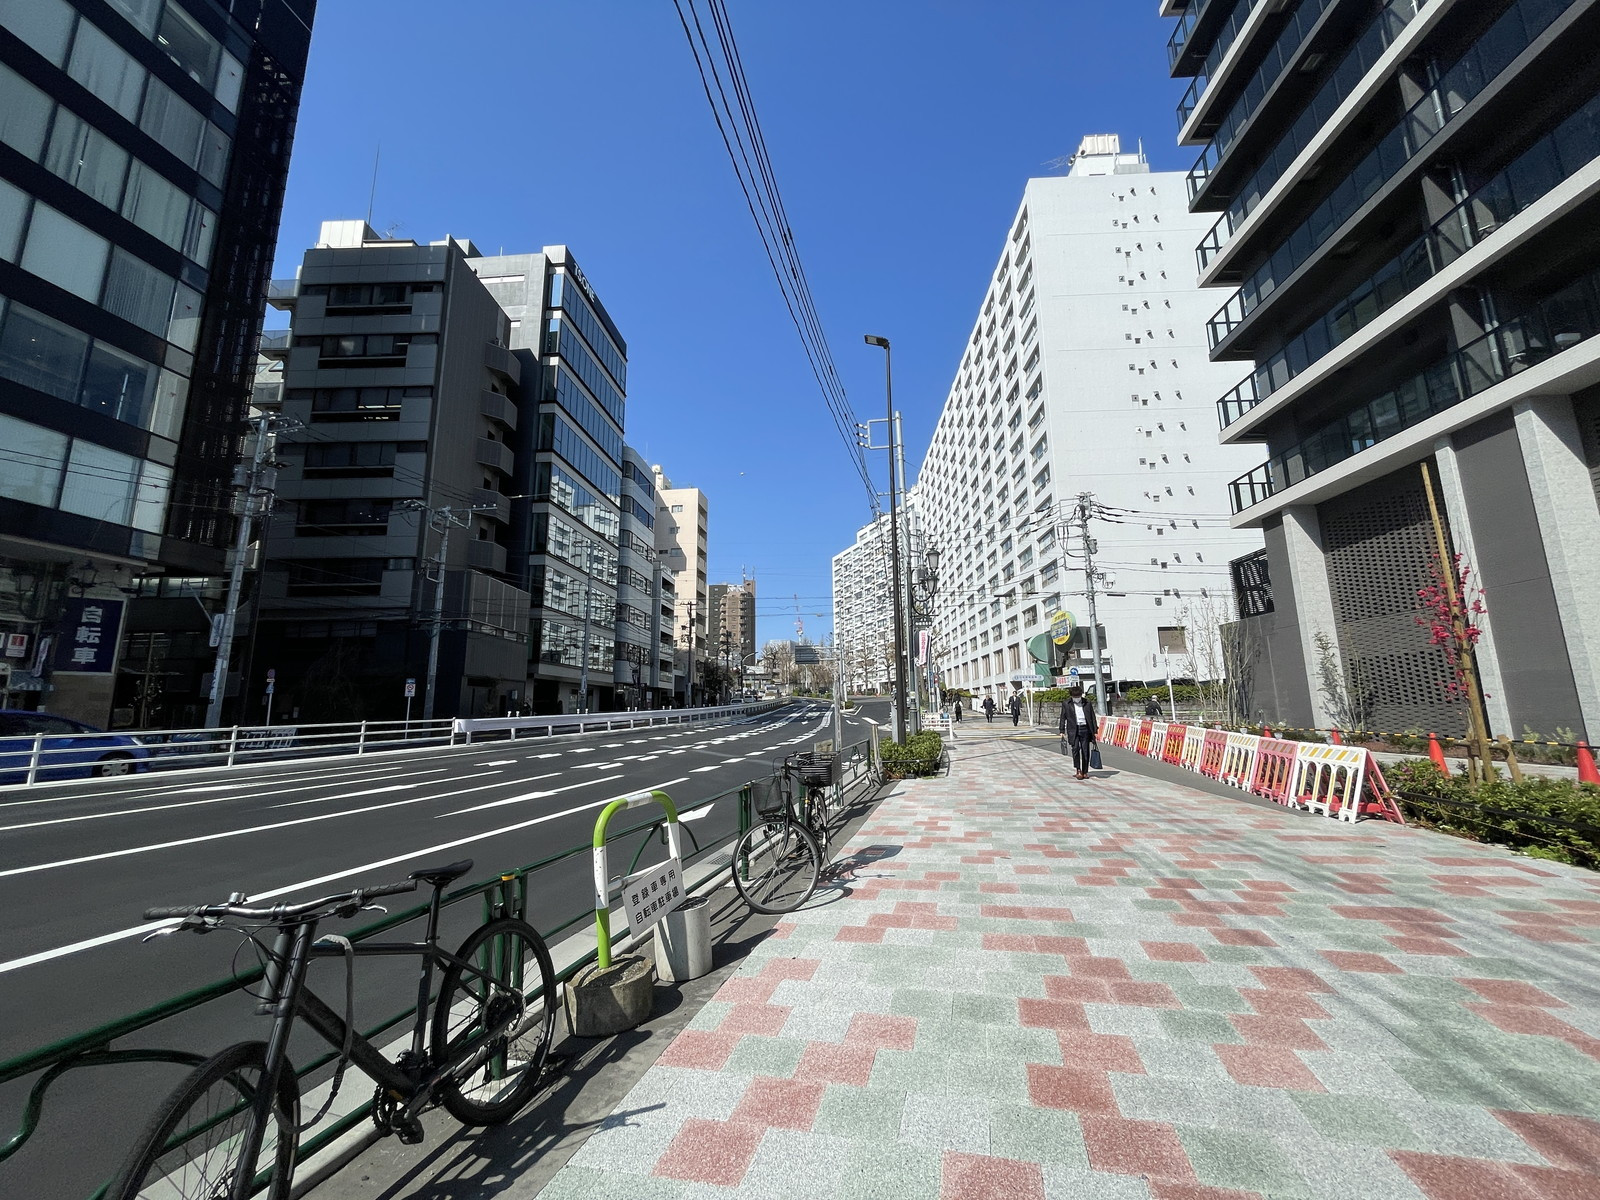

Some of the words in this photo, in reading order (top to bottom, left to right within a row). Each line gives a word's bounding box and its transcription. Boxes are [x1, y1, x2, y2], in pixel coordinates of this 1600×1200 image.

[71, 605, 103, 665] 自転車
[631, 869, 675, 906] 登録車専用
[635, 886, 679, 924] 自転車駐車場
